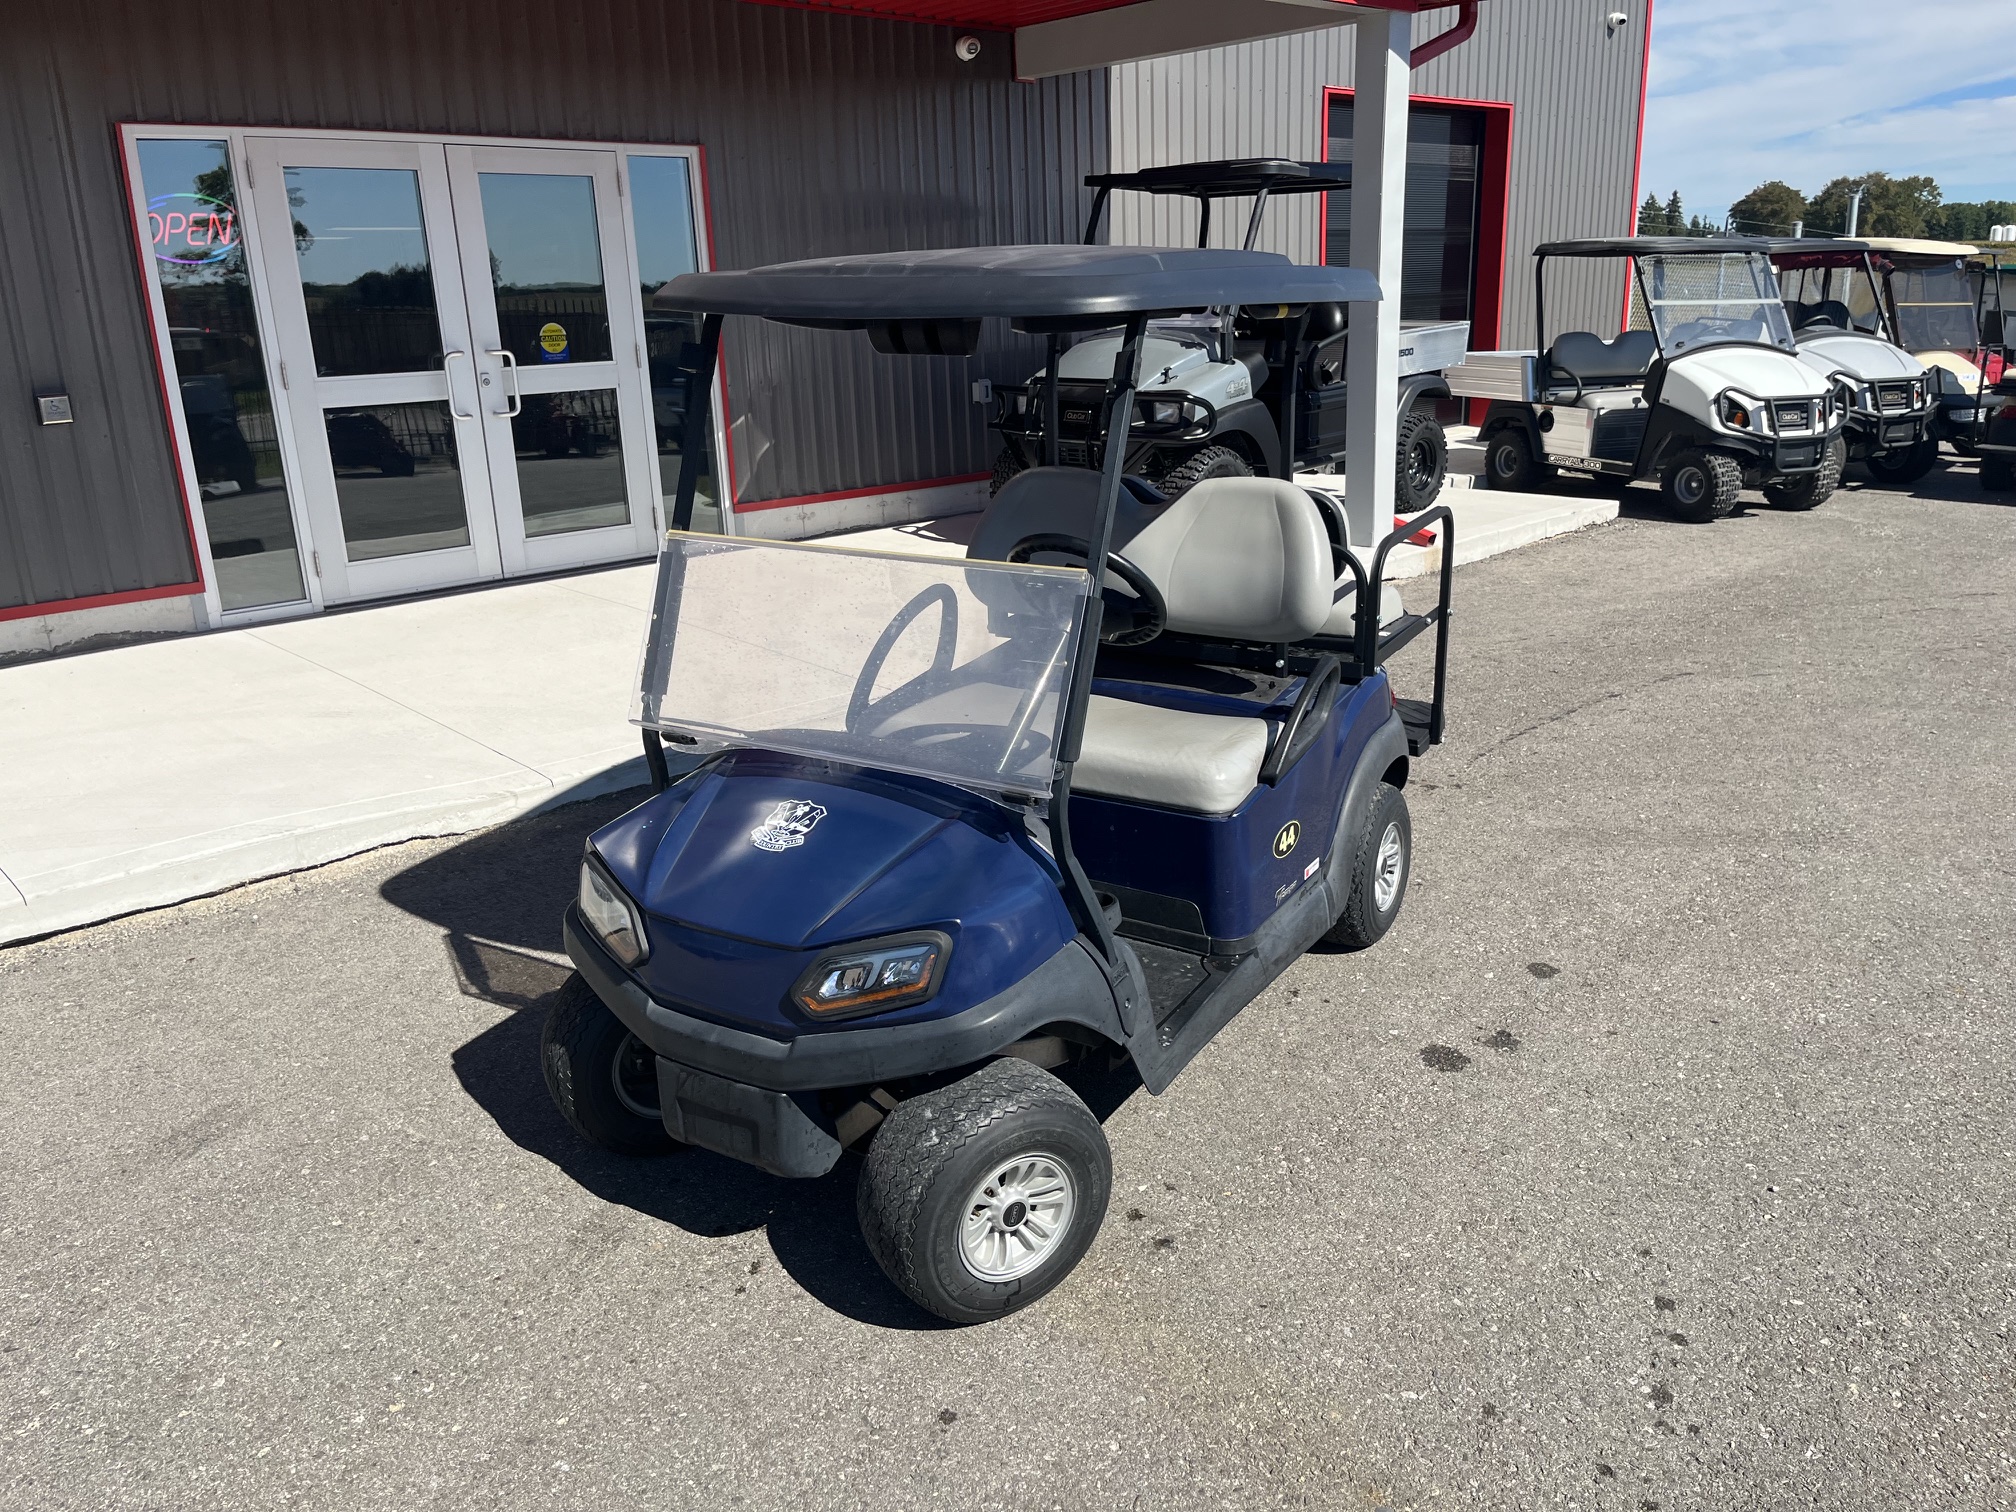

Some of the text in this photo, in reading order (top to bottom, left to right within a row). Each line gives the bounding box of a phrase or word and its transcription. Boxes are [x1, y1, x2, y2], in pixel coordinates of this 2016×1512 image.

[148, 212, 233, 246] OPEN
[1549, 455, 1602, 470] CARRYALL 300
[1279, 824, 1296, 852] 44
